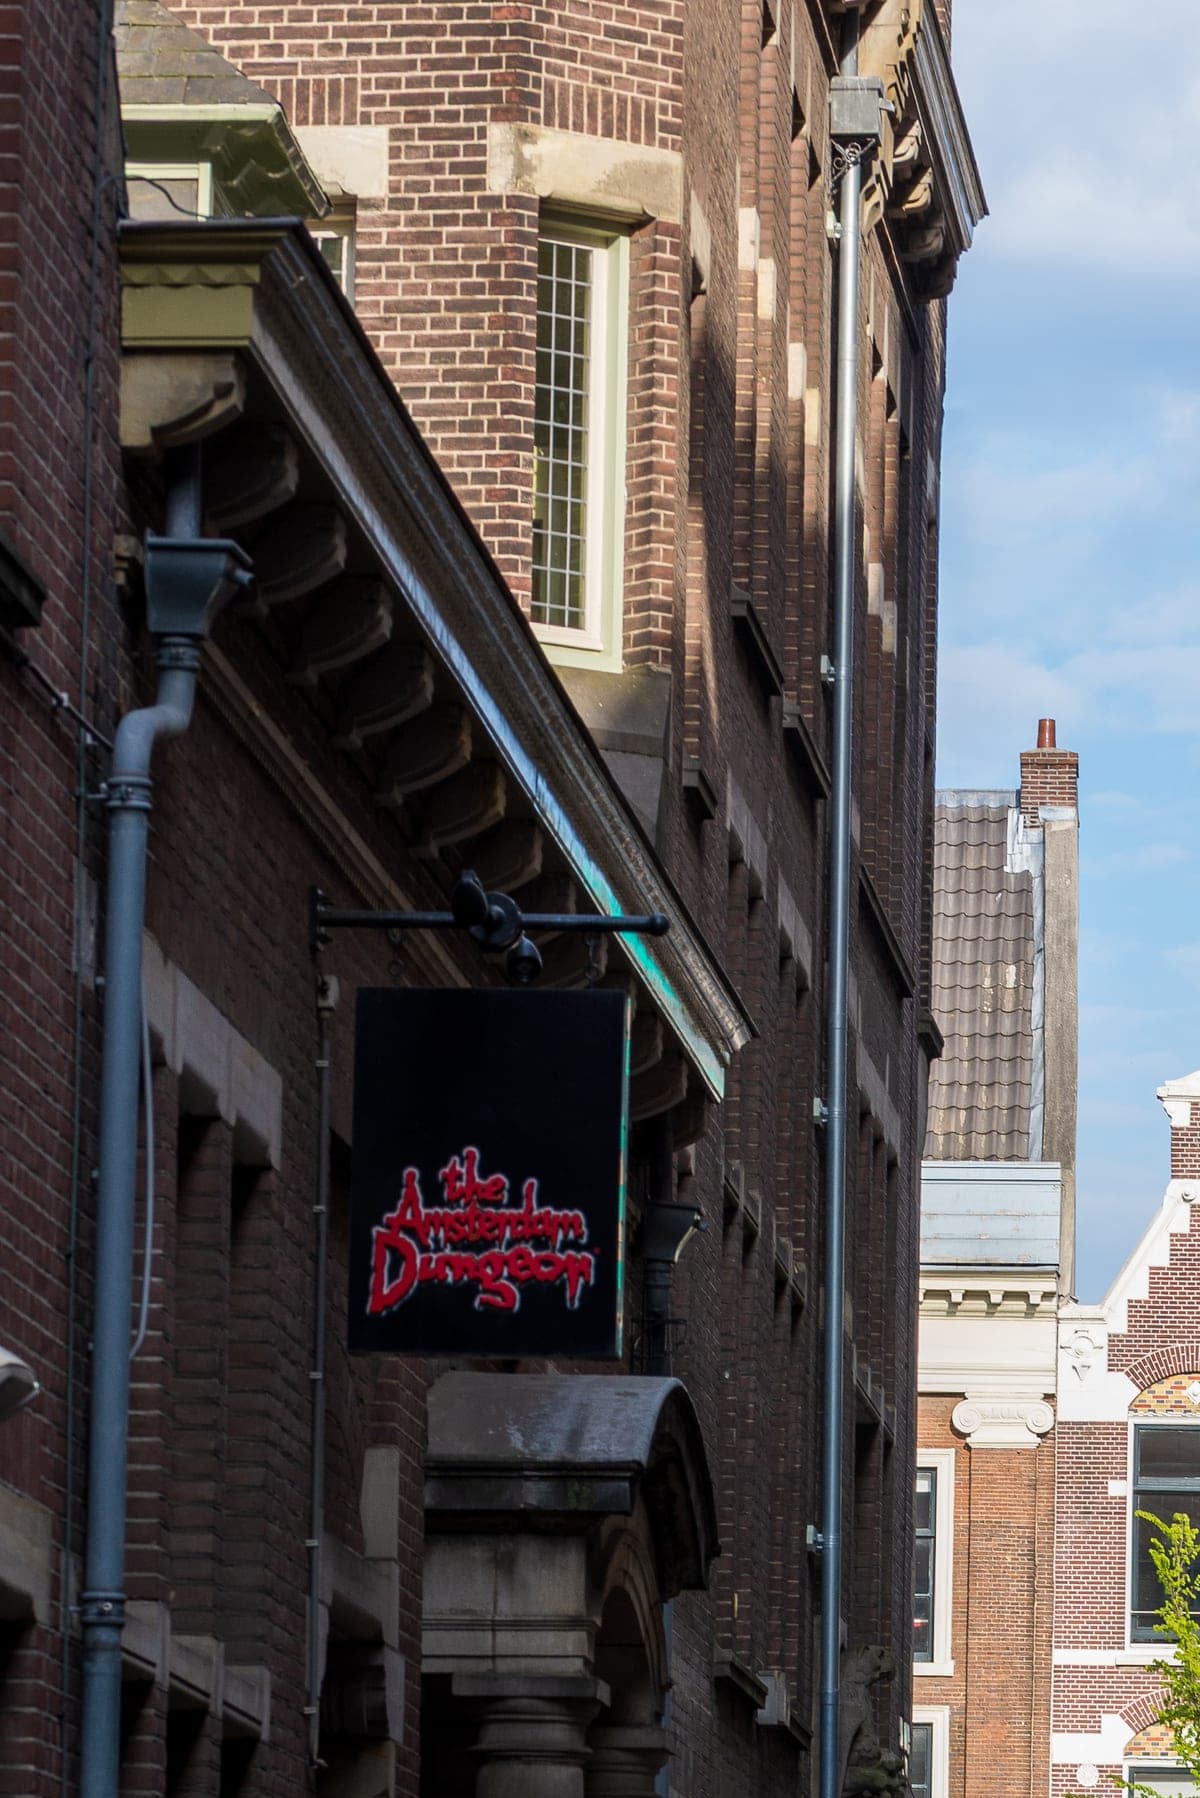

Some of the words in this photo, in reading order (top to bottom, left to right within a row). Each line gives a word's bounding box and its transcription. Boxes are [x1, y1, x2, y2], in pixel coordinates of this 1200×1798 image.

[384, 1167, 588, 1250] Amsterdam
[438, 1147, 509, 1205] the
[367, 1227, 595, 1315] Dungeon
